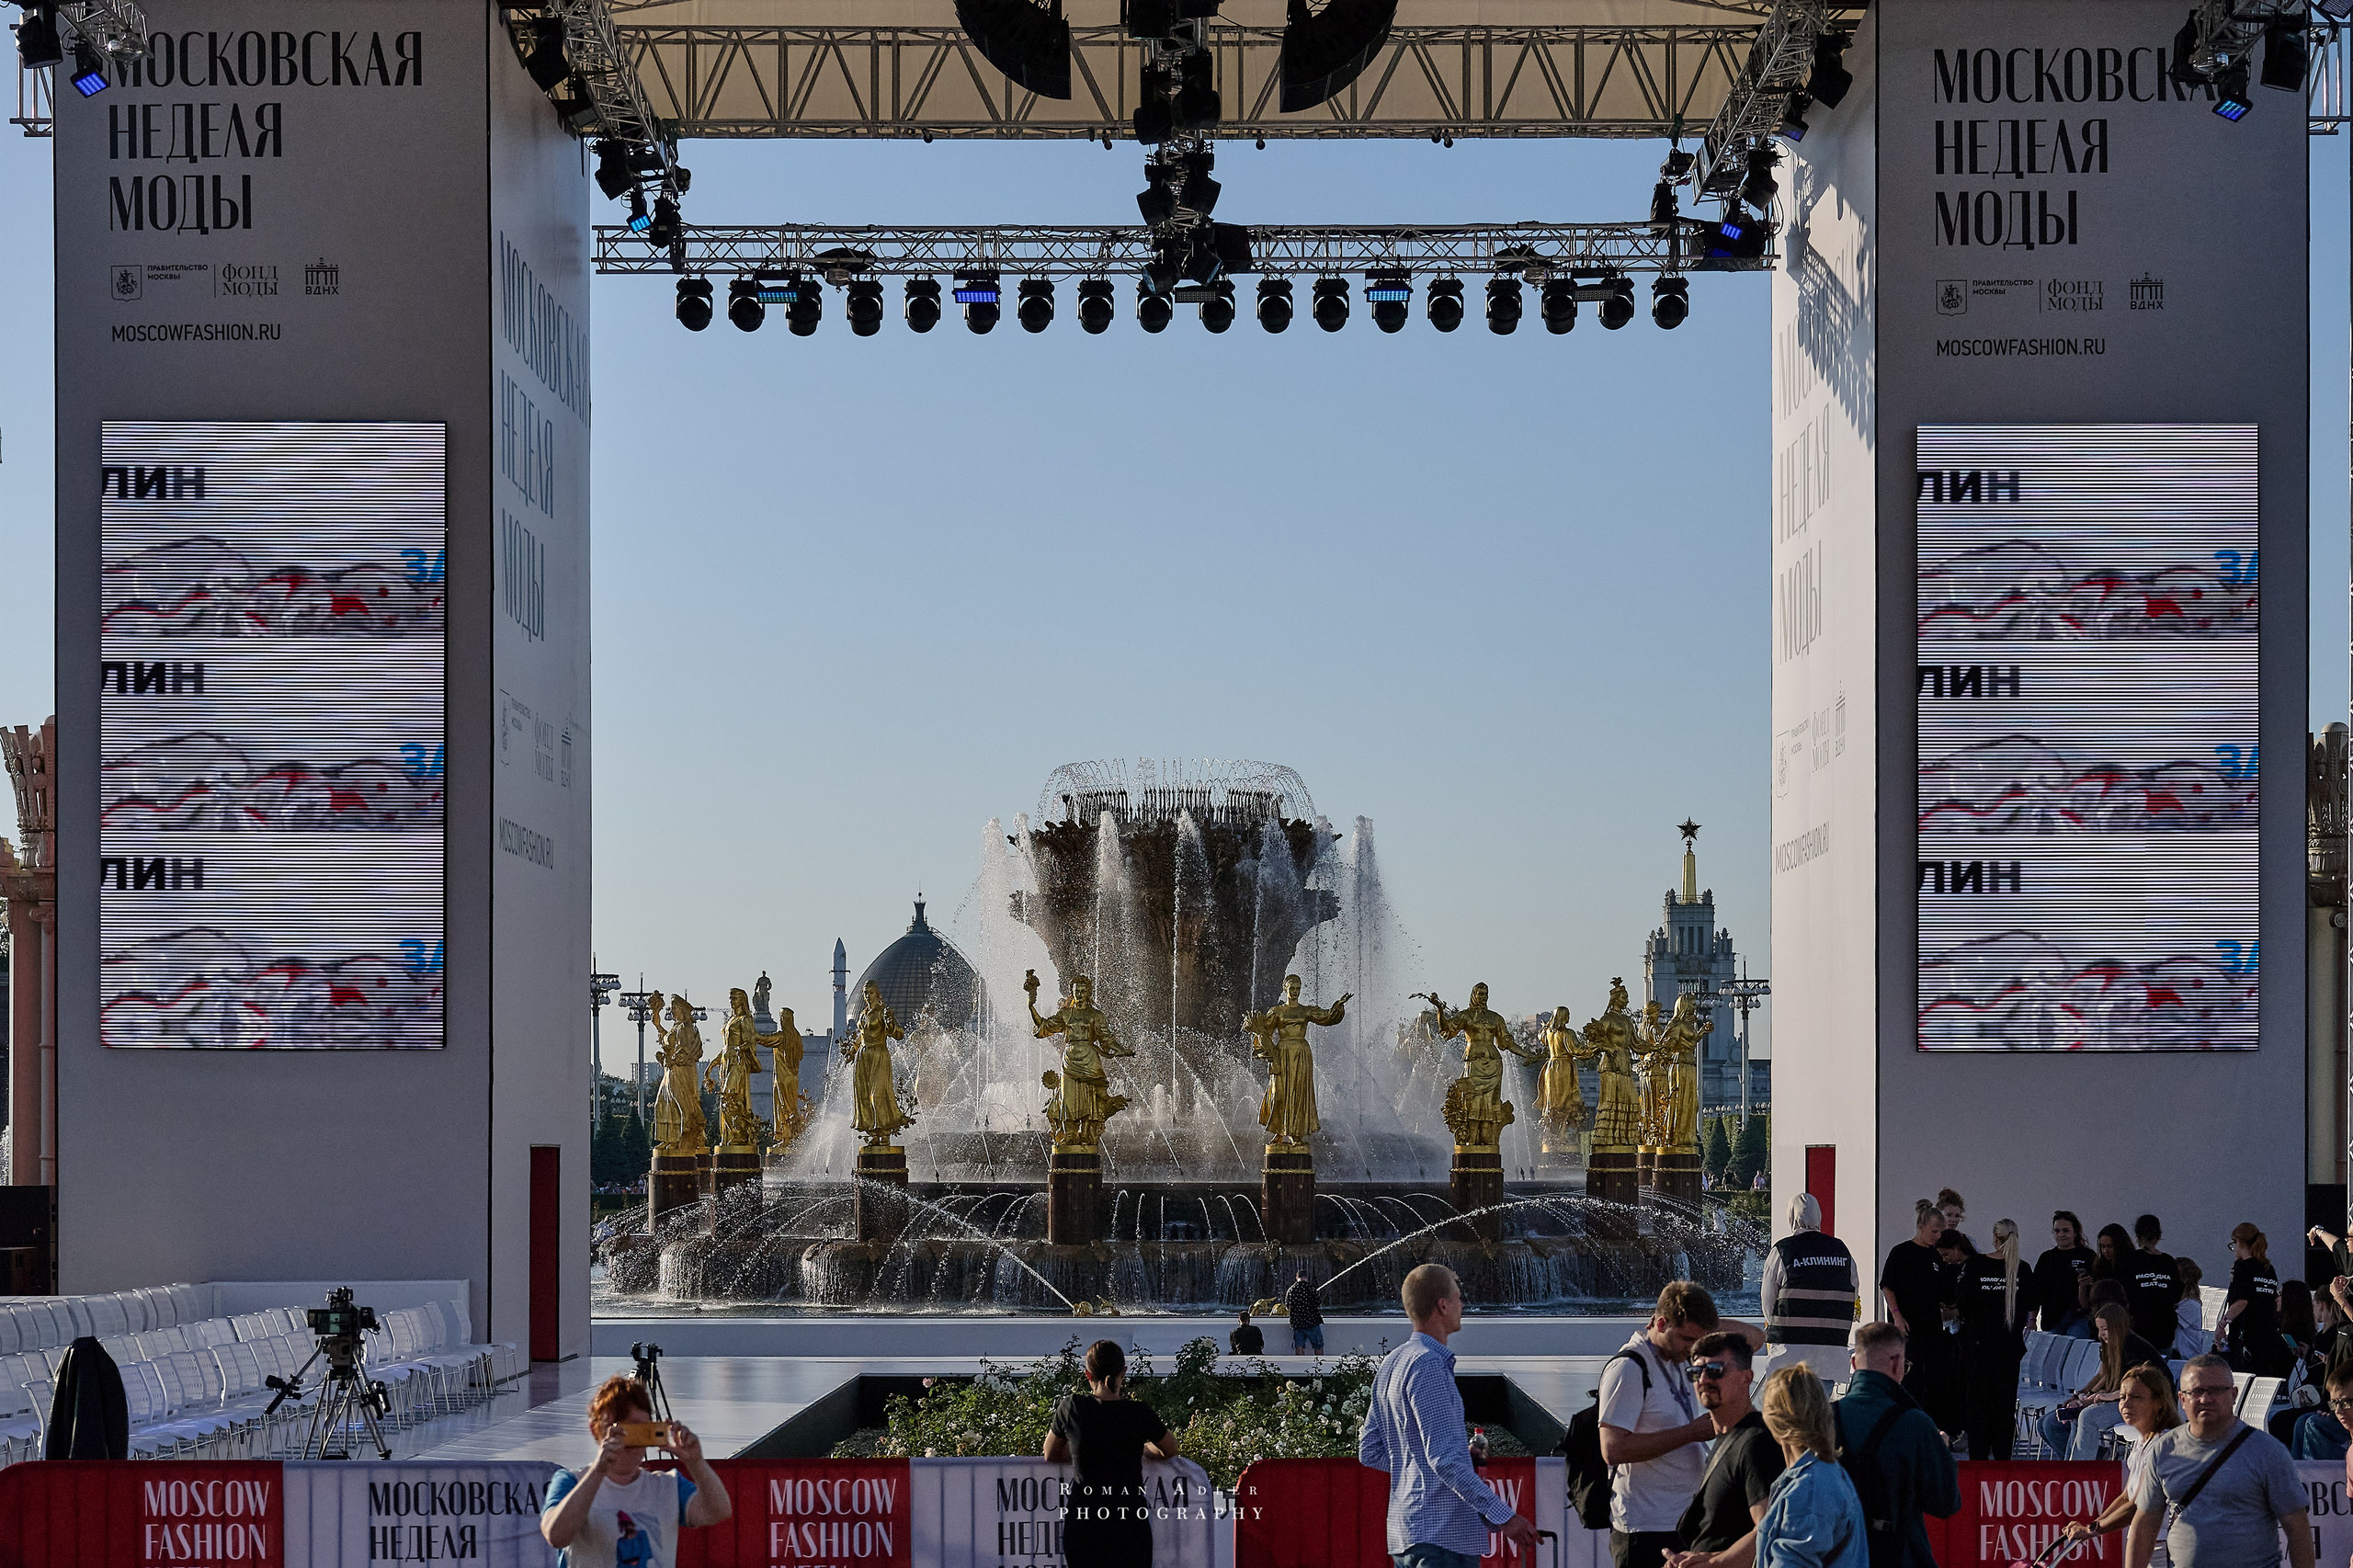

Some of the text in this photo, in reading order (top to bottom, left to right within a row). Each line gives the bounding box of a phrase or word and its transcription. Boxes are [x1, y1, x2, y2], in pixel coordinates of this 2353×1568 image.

[1934, 47, 2216, 104] МОСКОВСК
[109, 103, 283, 164] НЕДЕЛЯ
[1935, 119, 2109, 179] НЕДЕЛЯ
[109, 174, 252, 235] МОДЫ
[1935, 189, 2077, 250] МОДЫ
[147, 264, 209, 272] ПРАВИТЕЛЬСТВО
[222, 263, 278, 282] ФОНД
[222, 282, 278, 298] МОДЫ
[304, 286, 339, 295] ВДНХ
[2047, 278, 2104, 298] ФОНД
[2047, 297, 2103, 312] МОДЫ
[2130, 301, 2164, 311] ВДНХ
[111, 324, 281, 343] MOSCOWFASHION.RU
[500, 230, 588, 429] МОСКОВСКАЯ
[1937, 338, 2106, 357] MOSCOWFASHION.RU
[501, 369, 553, 519] НЕДЕЛЯ
[1779, 402, 1830, 544] НЕДЕЛЯ
[501, 507, 544, 642] МОДЫ
[1779, 540, 1823, 665] МОДЫ
[1793, 1256, 1847, 1267] А-КЛИНИНГ
[144, 1481, 270, 1517] MOSCOW
[770, 1478, 897, 1515] MOSCOW
[1980, 1480, 2109, 1517] MOSCOW
[145, 1524, 266, 1560] FASHION
[370, 1525, 477, 1562] НЕДЕЛЯ
[770, 1521, 893, 1558] FASHION
